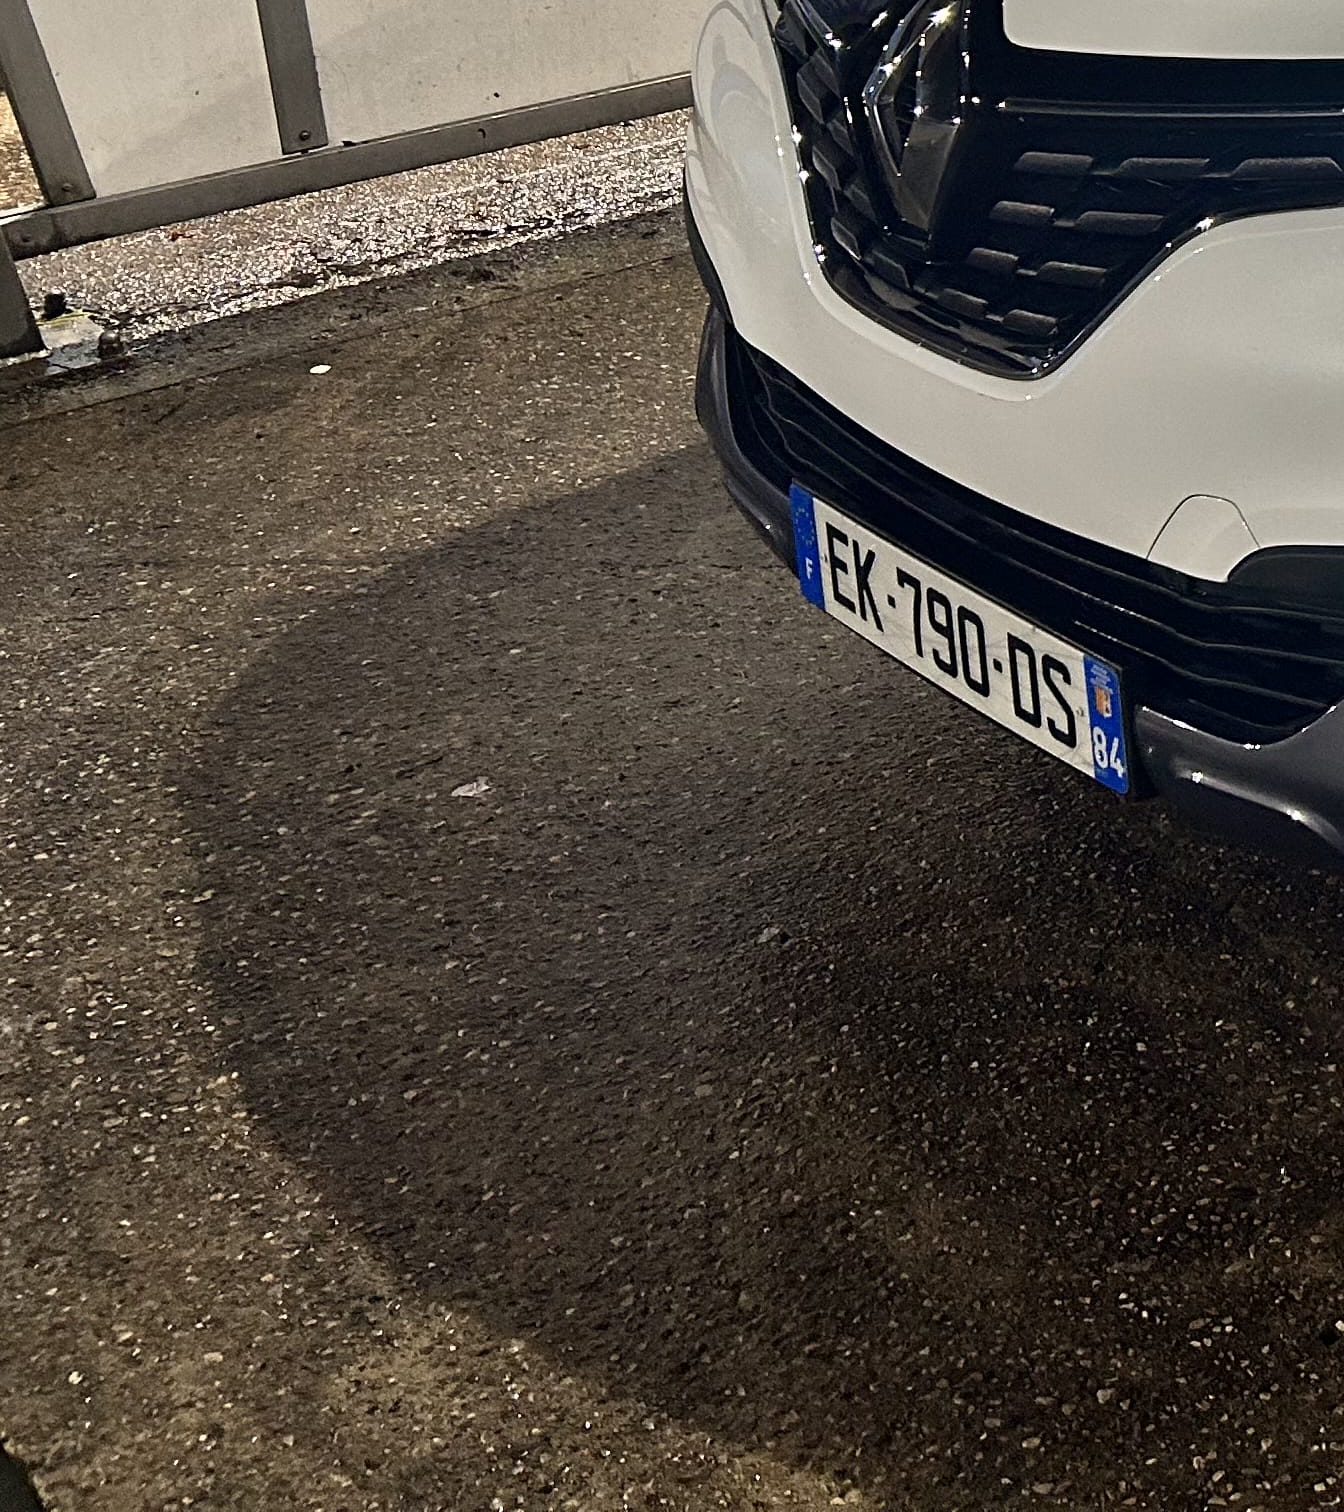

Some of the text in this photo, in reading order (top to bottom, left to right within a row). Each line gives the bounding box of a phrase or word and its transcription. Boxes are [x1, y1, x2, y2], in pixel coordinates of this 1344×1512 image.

[805, 557, 813, 580] F
[826, 522, 1077, 748] EK-790-DS
[1092, 726, 1124, 778] 84
